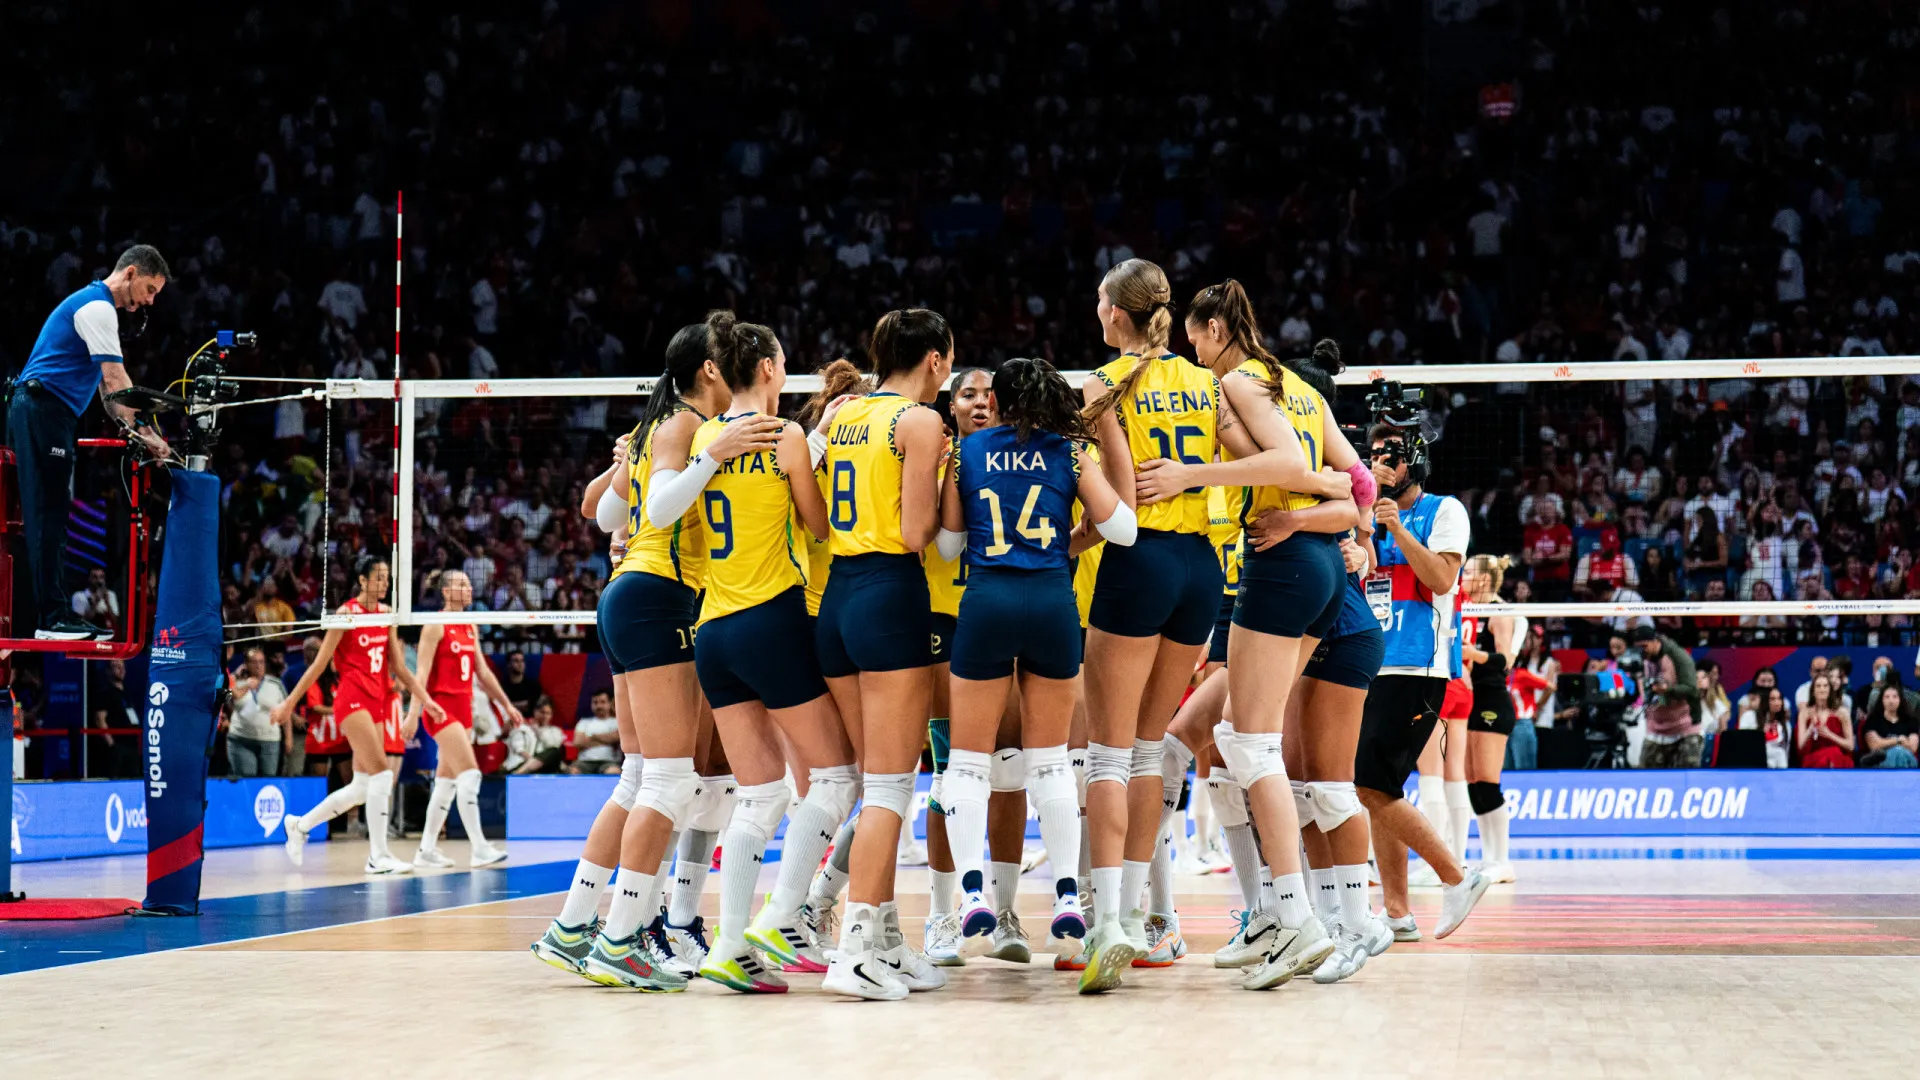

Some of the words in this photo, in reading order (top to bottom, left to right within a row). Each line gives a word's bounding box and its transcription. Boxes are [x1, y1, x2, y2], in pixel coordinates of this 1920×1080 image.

[1135, 390, 1212, 414] HELENA
[831, 424, 869, 445] JULIA
[986, 451, 1047, 472] KIKA
[830, 460, 857, 531] 8
[705, 490, 734, 559] 9
[980, 485, 1057, 556] 14
[367, 646, 384, 674] 15
[461, 655, 471, 681] 9
[148, 708, 168, 798] Senoh
[1503, 787, 1749, 820] BALLWORLD.COM
